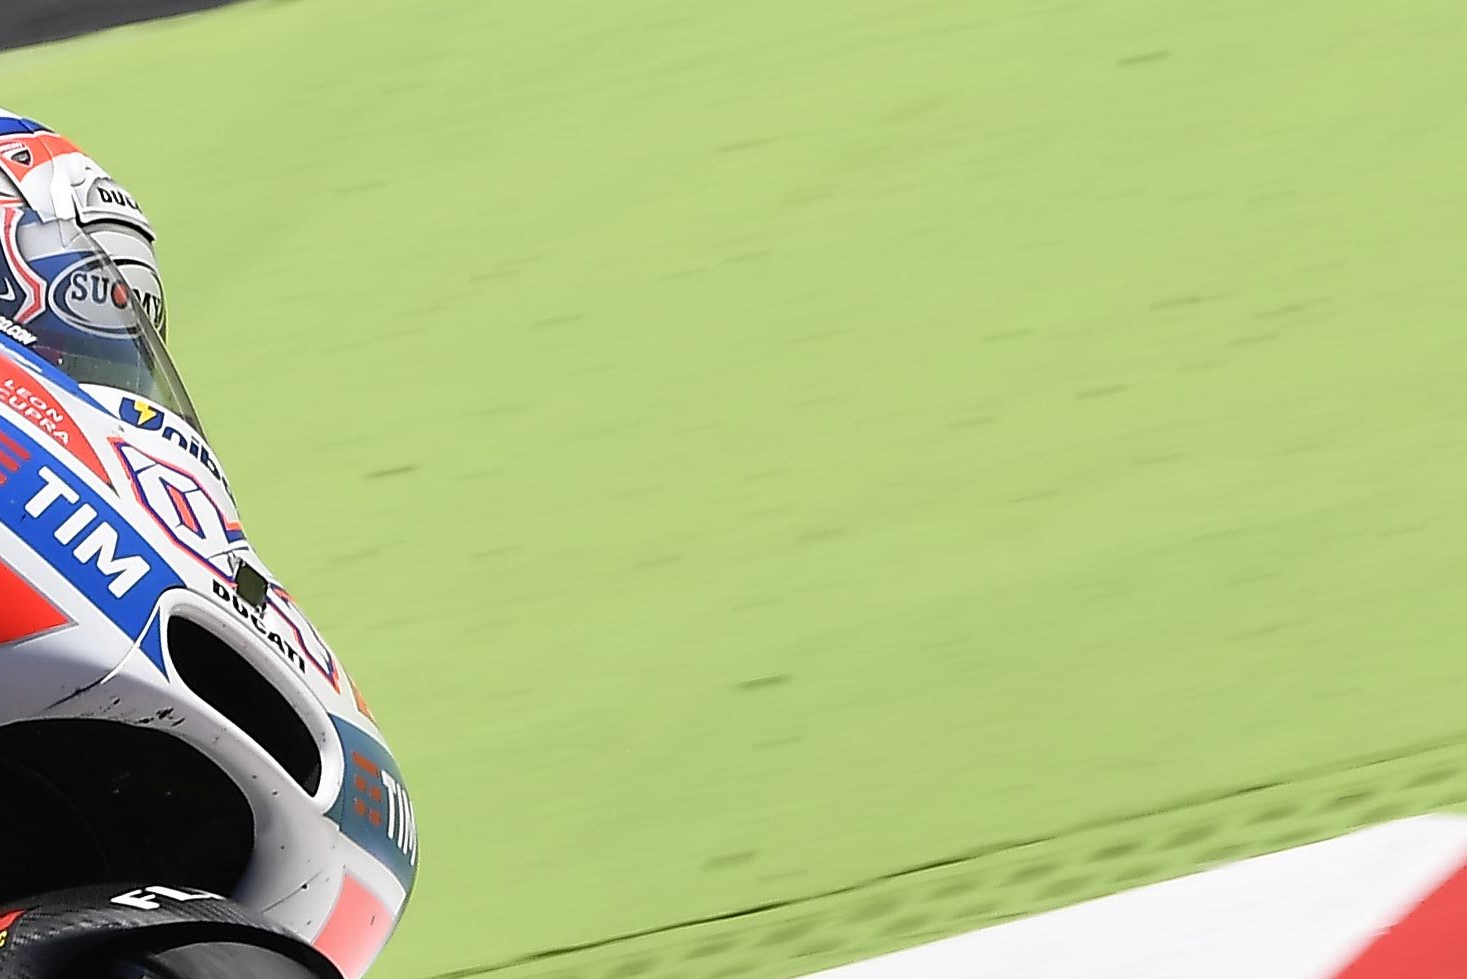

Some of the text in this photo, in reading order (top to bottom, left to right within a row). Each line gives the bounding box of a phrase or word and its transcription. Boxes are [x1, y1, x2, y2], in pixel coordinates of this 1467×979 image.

[70, 272, 162, 328] SUOMY
[3, 378, 44, 423] LEON
[117, 395, 237, 510] Unib
[23, 464, 152, 600] TIM
